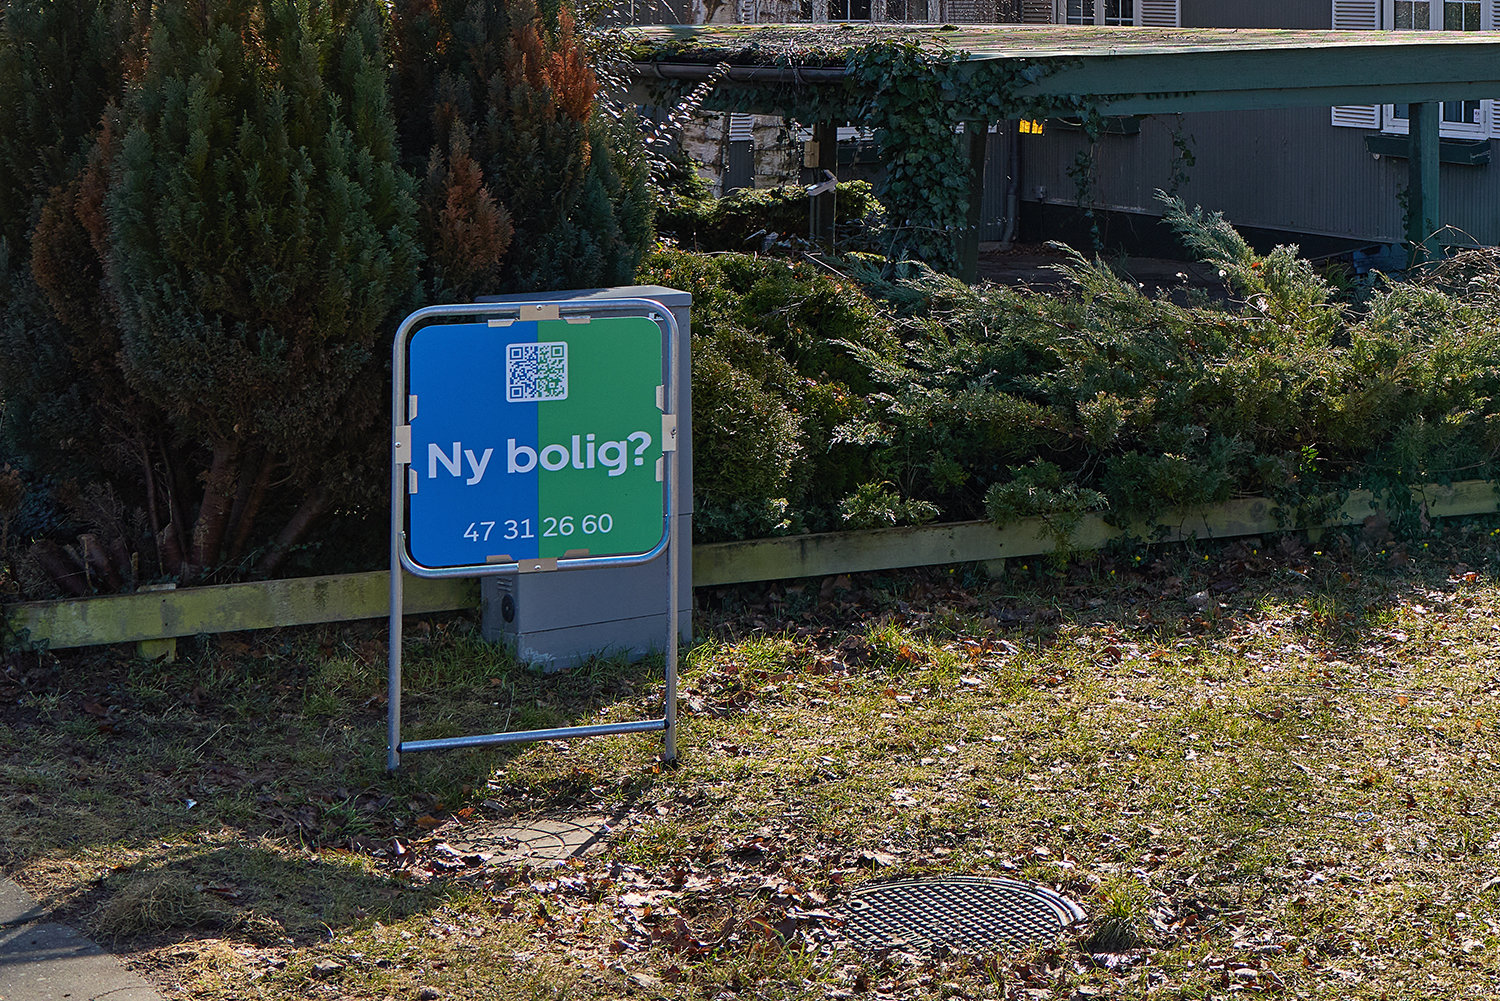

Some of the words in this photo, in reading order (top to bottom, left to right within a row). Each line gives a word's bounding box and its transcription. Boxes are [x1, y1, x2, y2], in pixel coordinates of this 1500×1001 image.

[428, 442, 493, 486] Ny
[507, 431, 652, 477] bolig?
[463, 521, 496, 542] 47
[503, 518, 535, 540] 31
[543, 516, 575, 537] 26
[581, 513, 613, 534] 60
